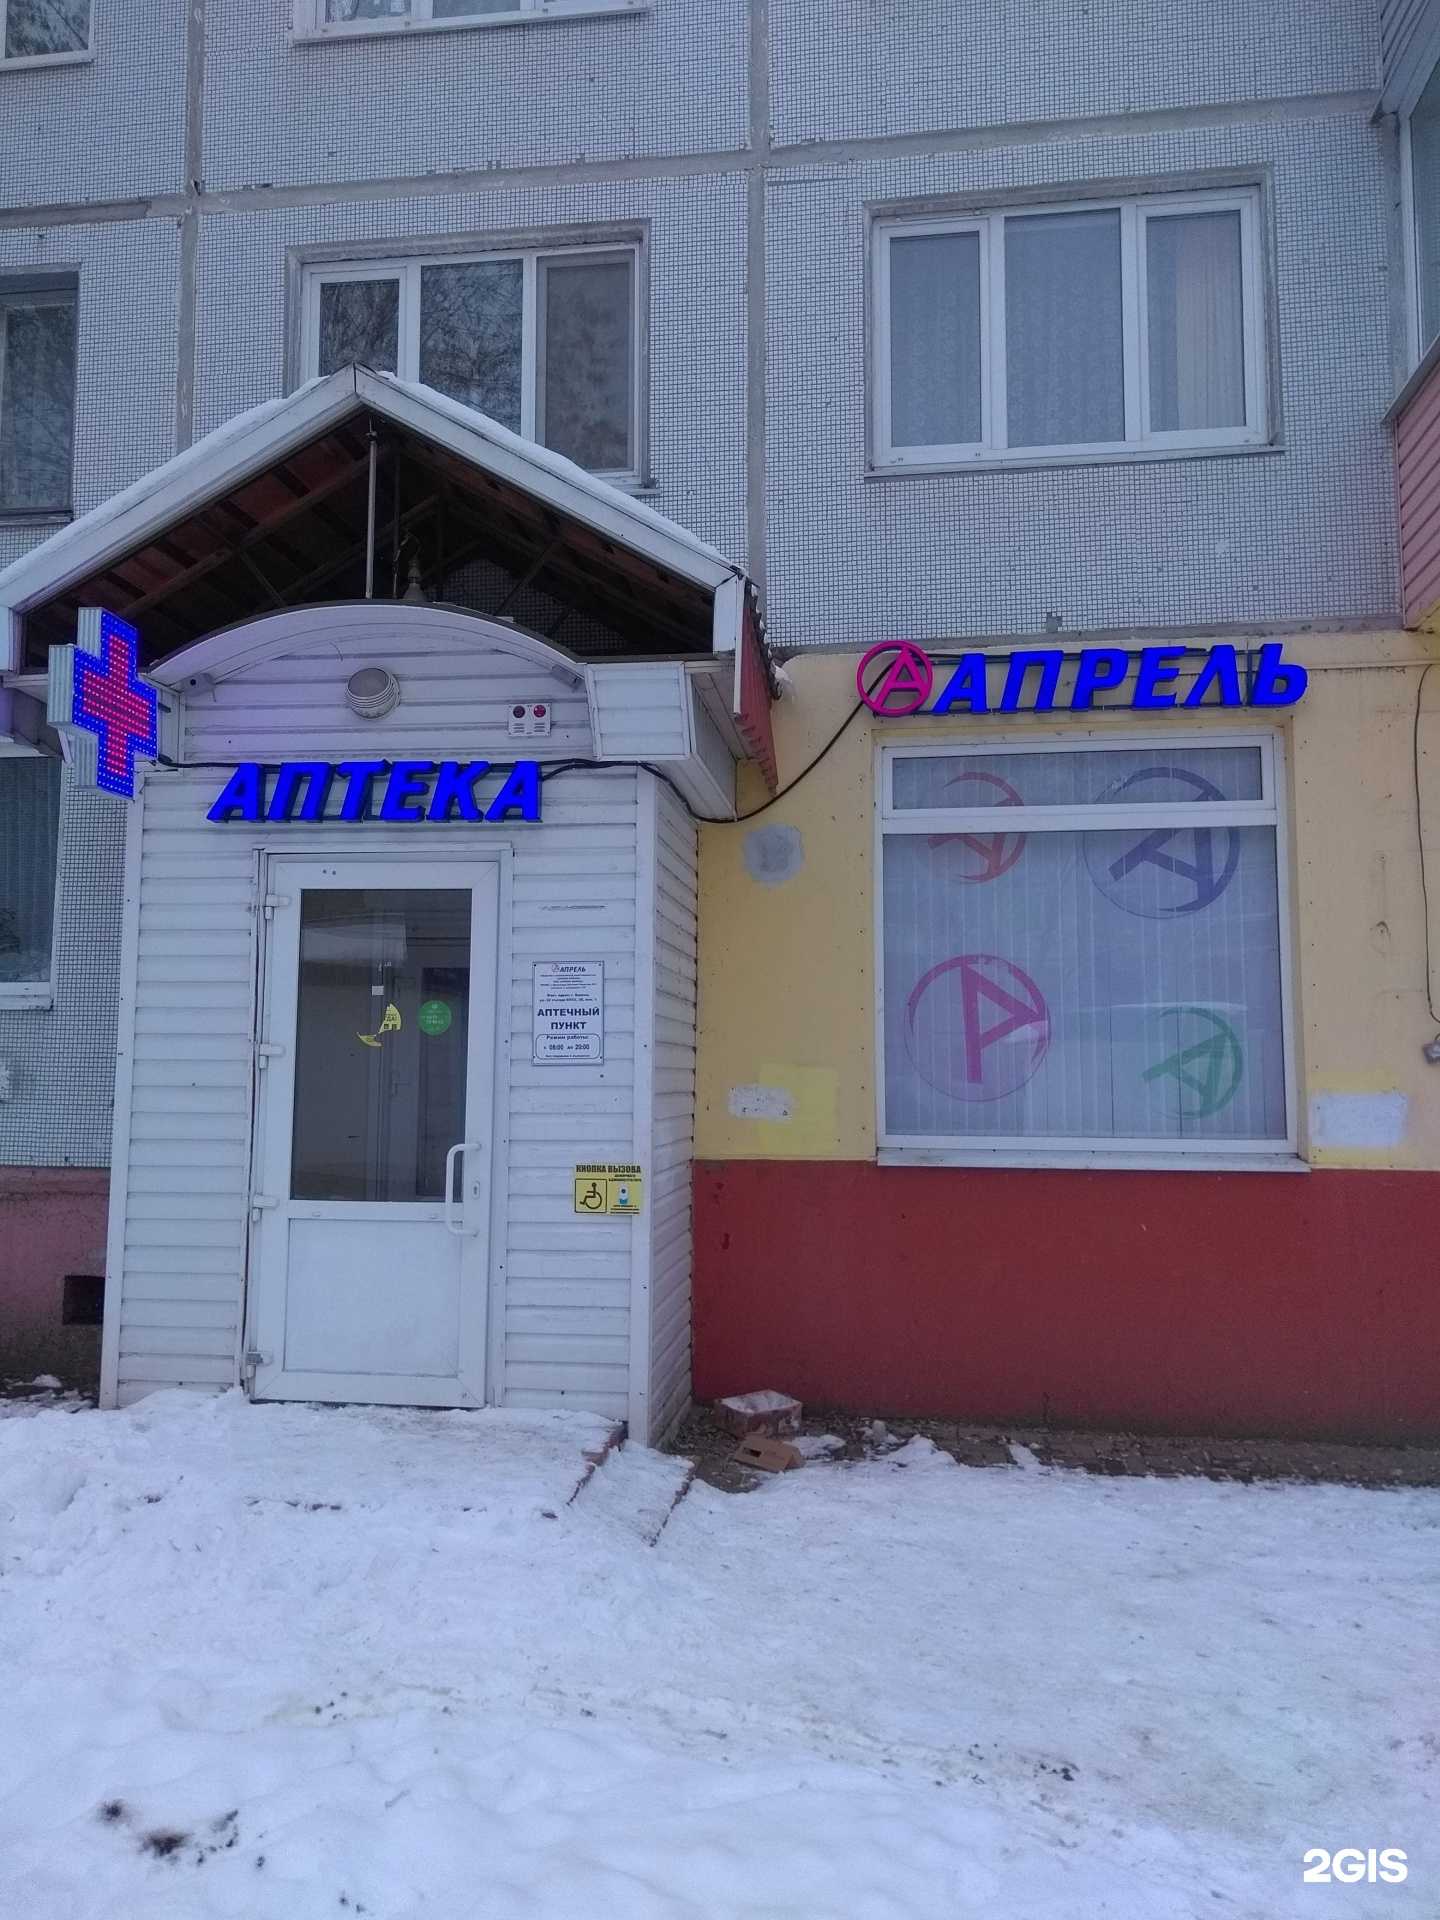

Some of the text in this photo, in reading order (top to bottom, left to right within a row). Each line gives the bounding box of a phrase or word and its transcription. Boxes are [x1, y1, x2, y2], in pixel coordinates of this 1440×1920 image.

[931, 643, 1308, 715] АПРЕЛЬ
[206, 760, 542, 823] АПТЕКА
[537, 1006, 600, 1017] АПТЕЧНЫЙ
[551, 1021, 587, 1030] ПУНКТ
[576, 1164, 641, 1173] КНОПКА ВЫЗОВА
